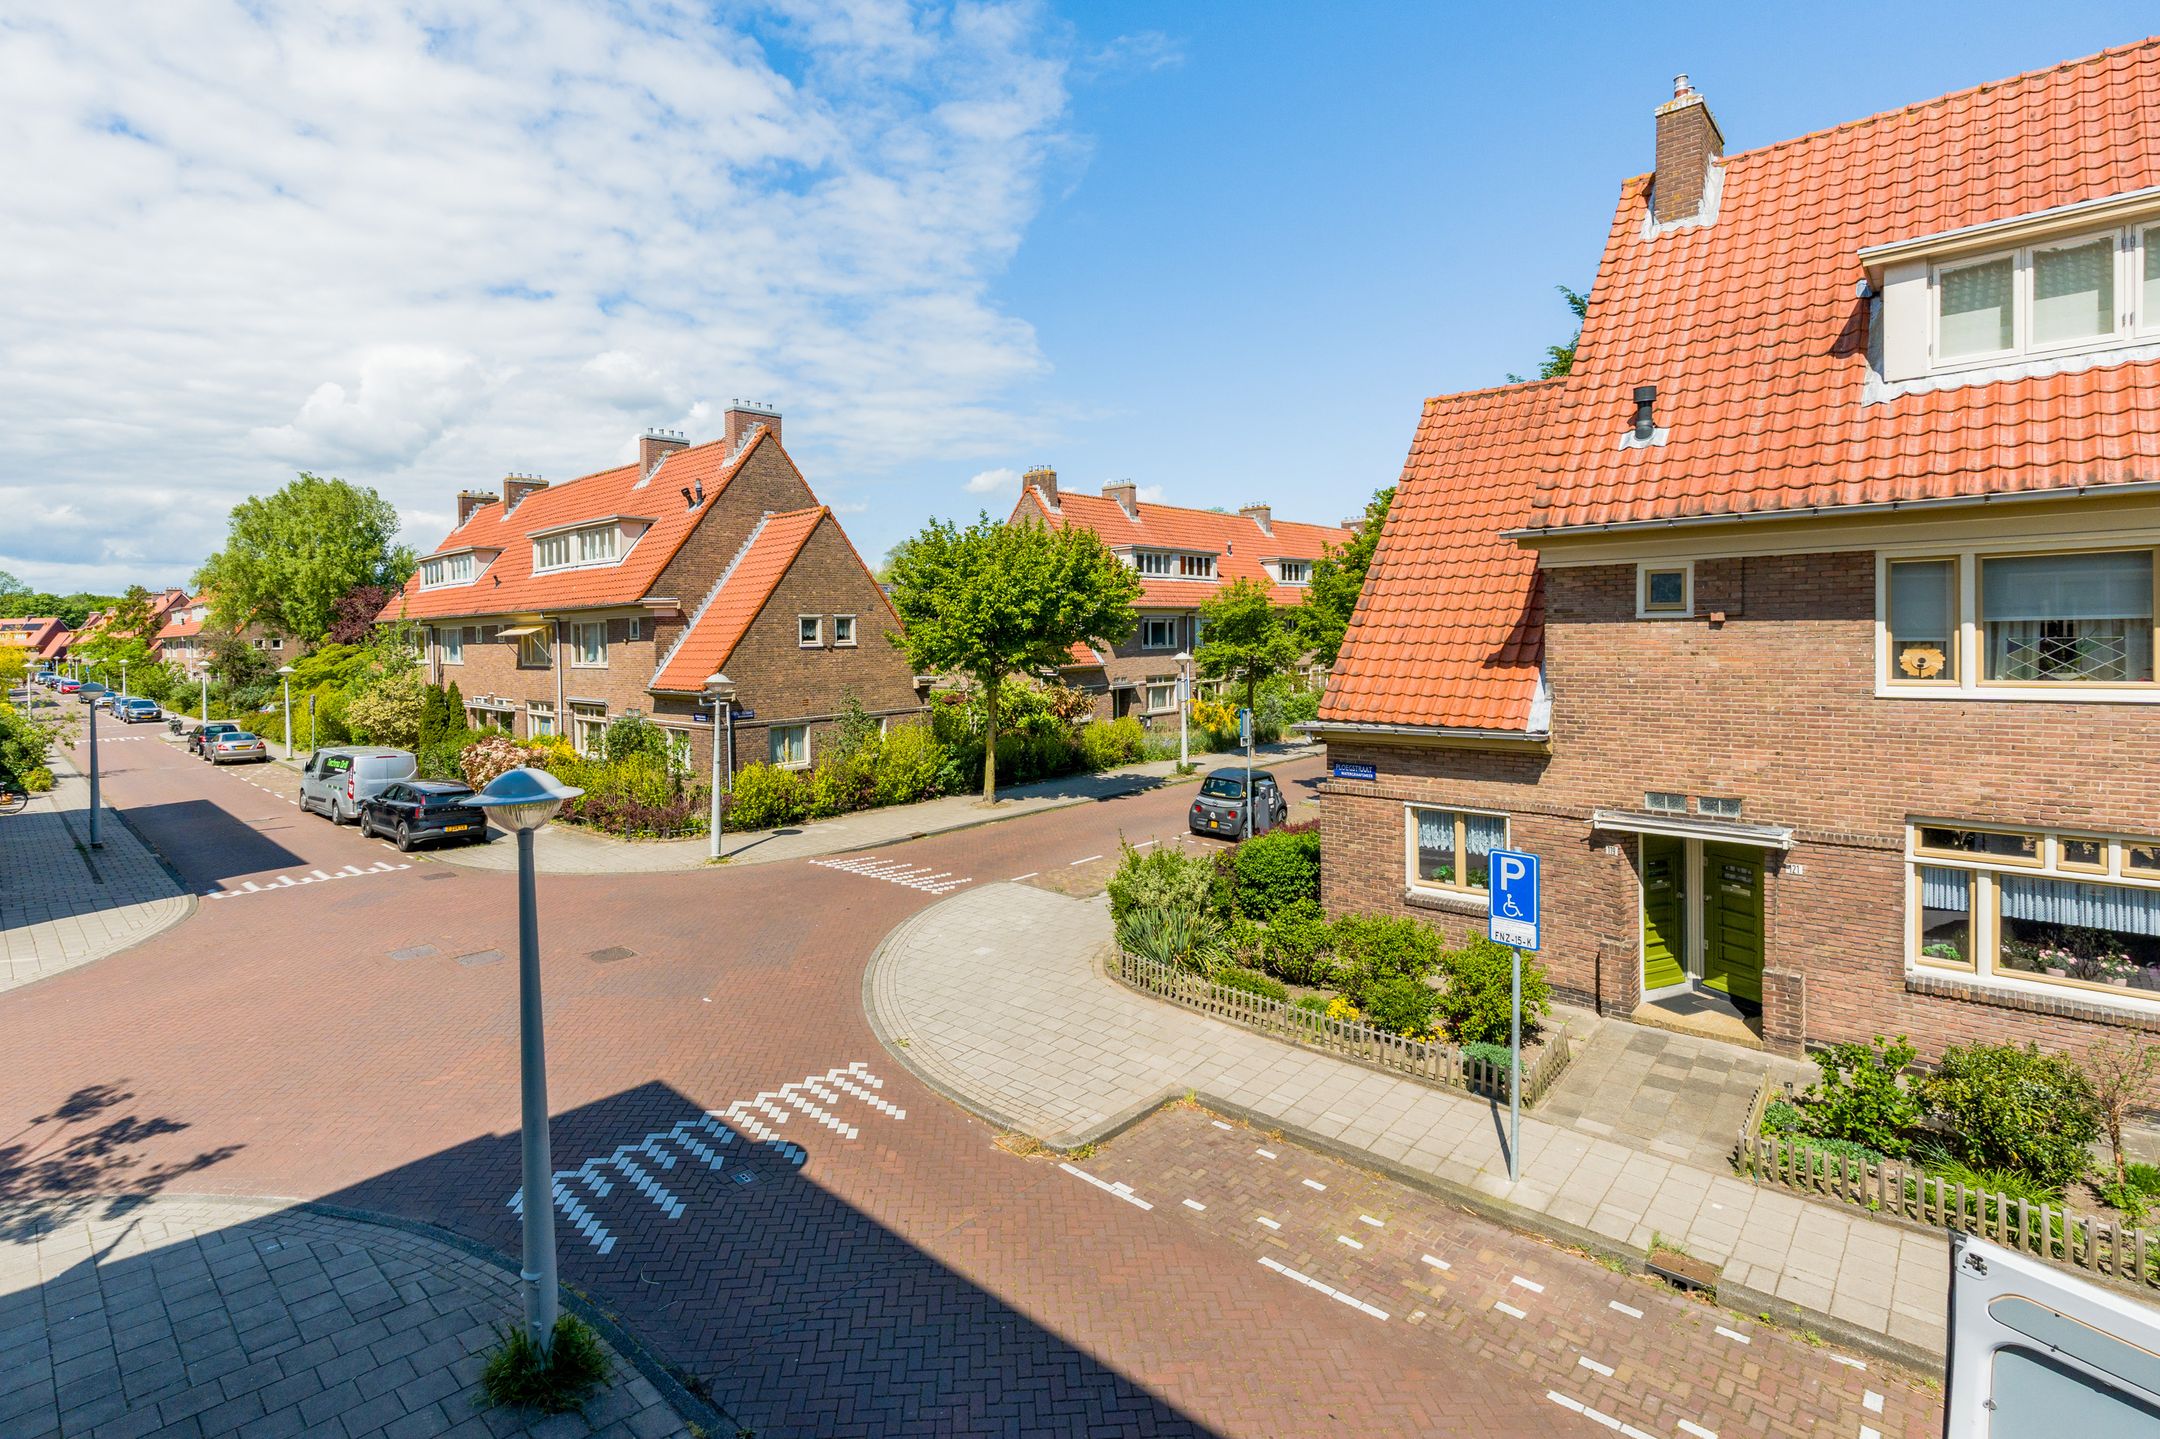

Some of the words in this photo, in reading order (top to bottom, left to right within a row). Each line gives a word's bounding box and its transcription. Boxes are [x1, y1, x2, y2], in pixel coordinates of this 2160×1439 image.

[1335, 763, 1373, 773] PLOEGSTRAAT
[1500, 856, 1526, 891] P
[1789, 864, 1800, 874] 121
[1494, 931, 1533, 948] FNZ-15-K
